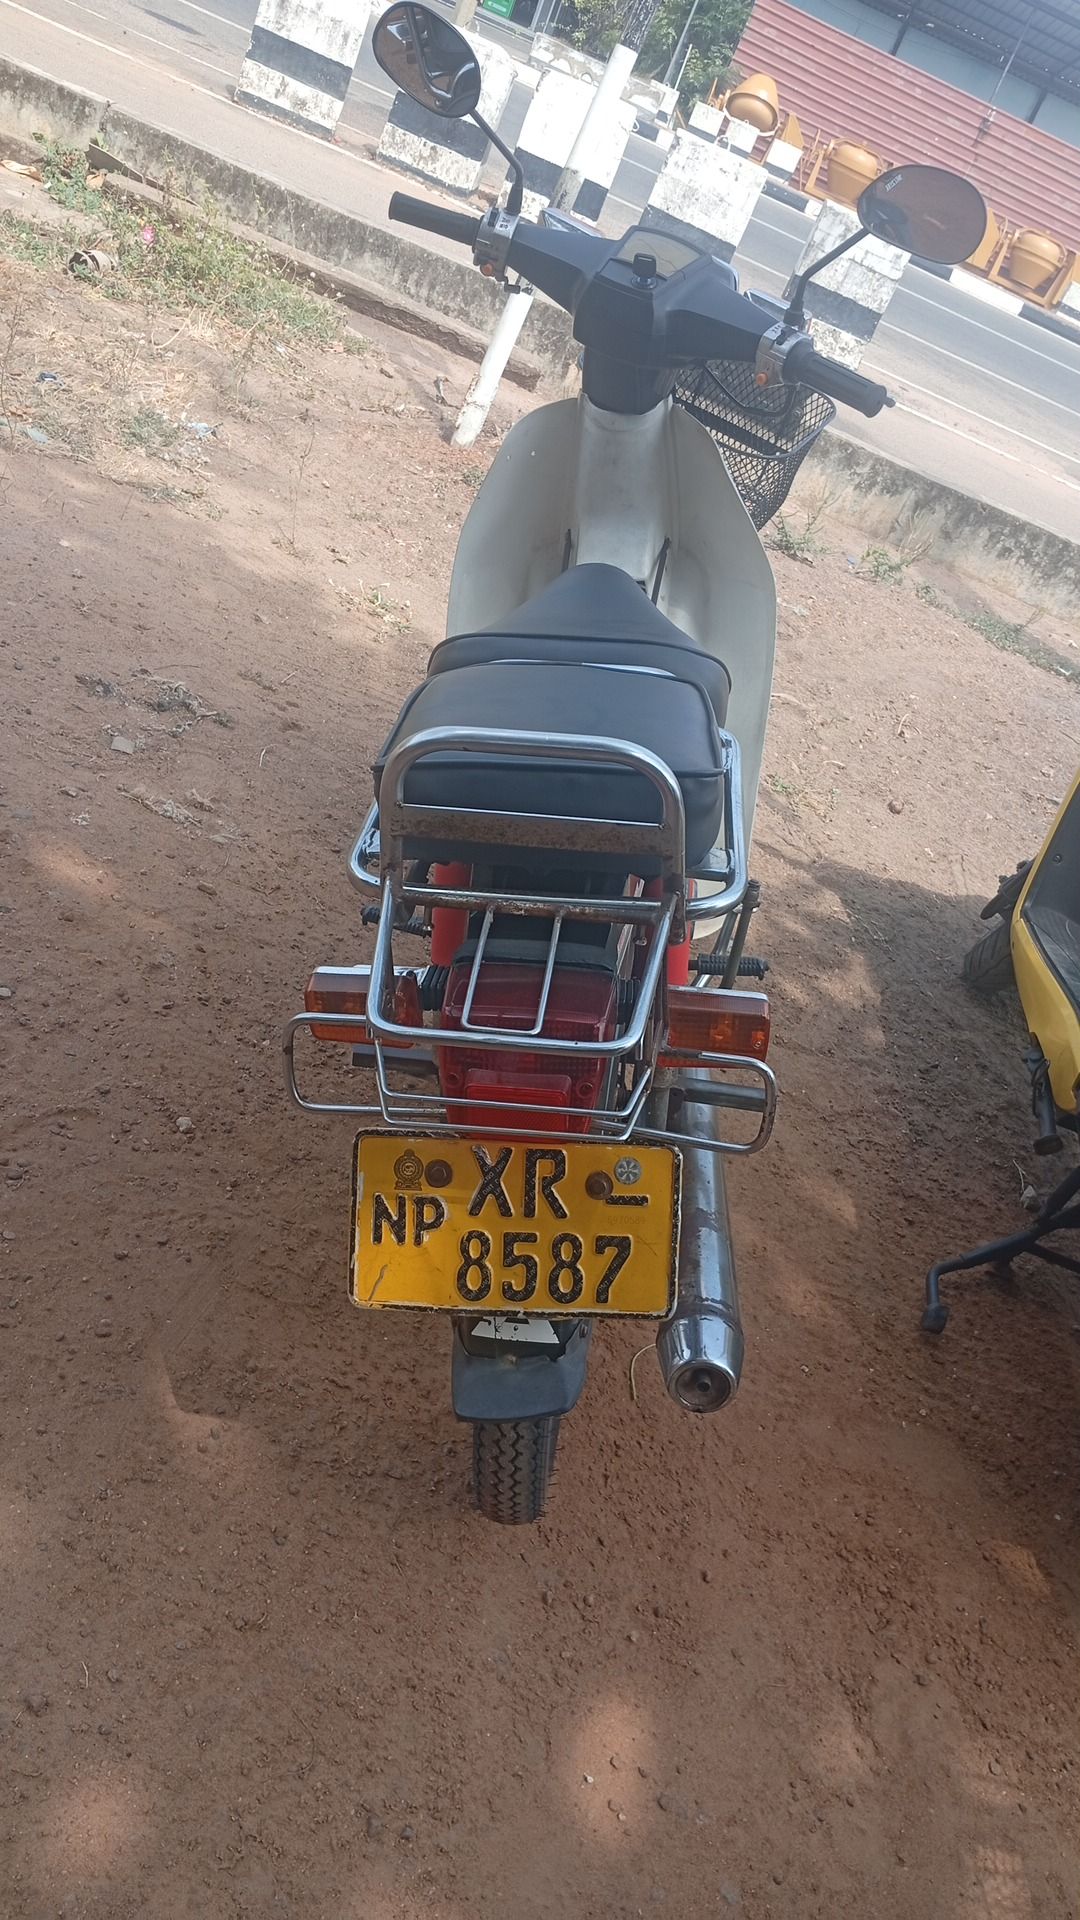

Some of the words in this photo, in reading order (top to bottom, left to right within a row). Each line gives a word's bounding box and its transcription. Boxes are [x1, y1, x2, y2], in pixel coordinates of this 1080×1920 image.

[469, 1145, 569, 1219] XR
[372, 1193, 446, 1247] NP
[456, 1230, 632, 1304] 8587
